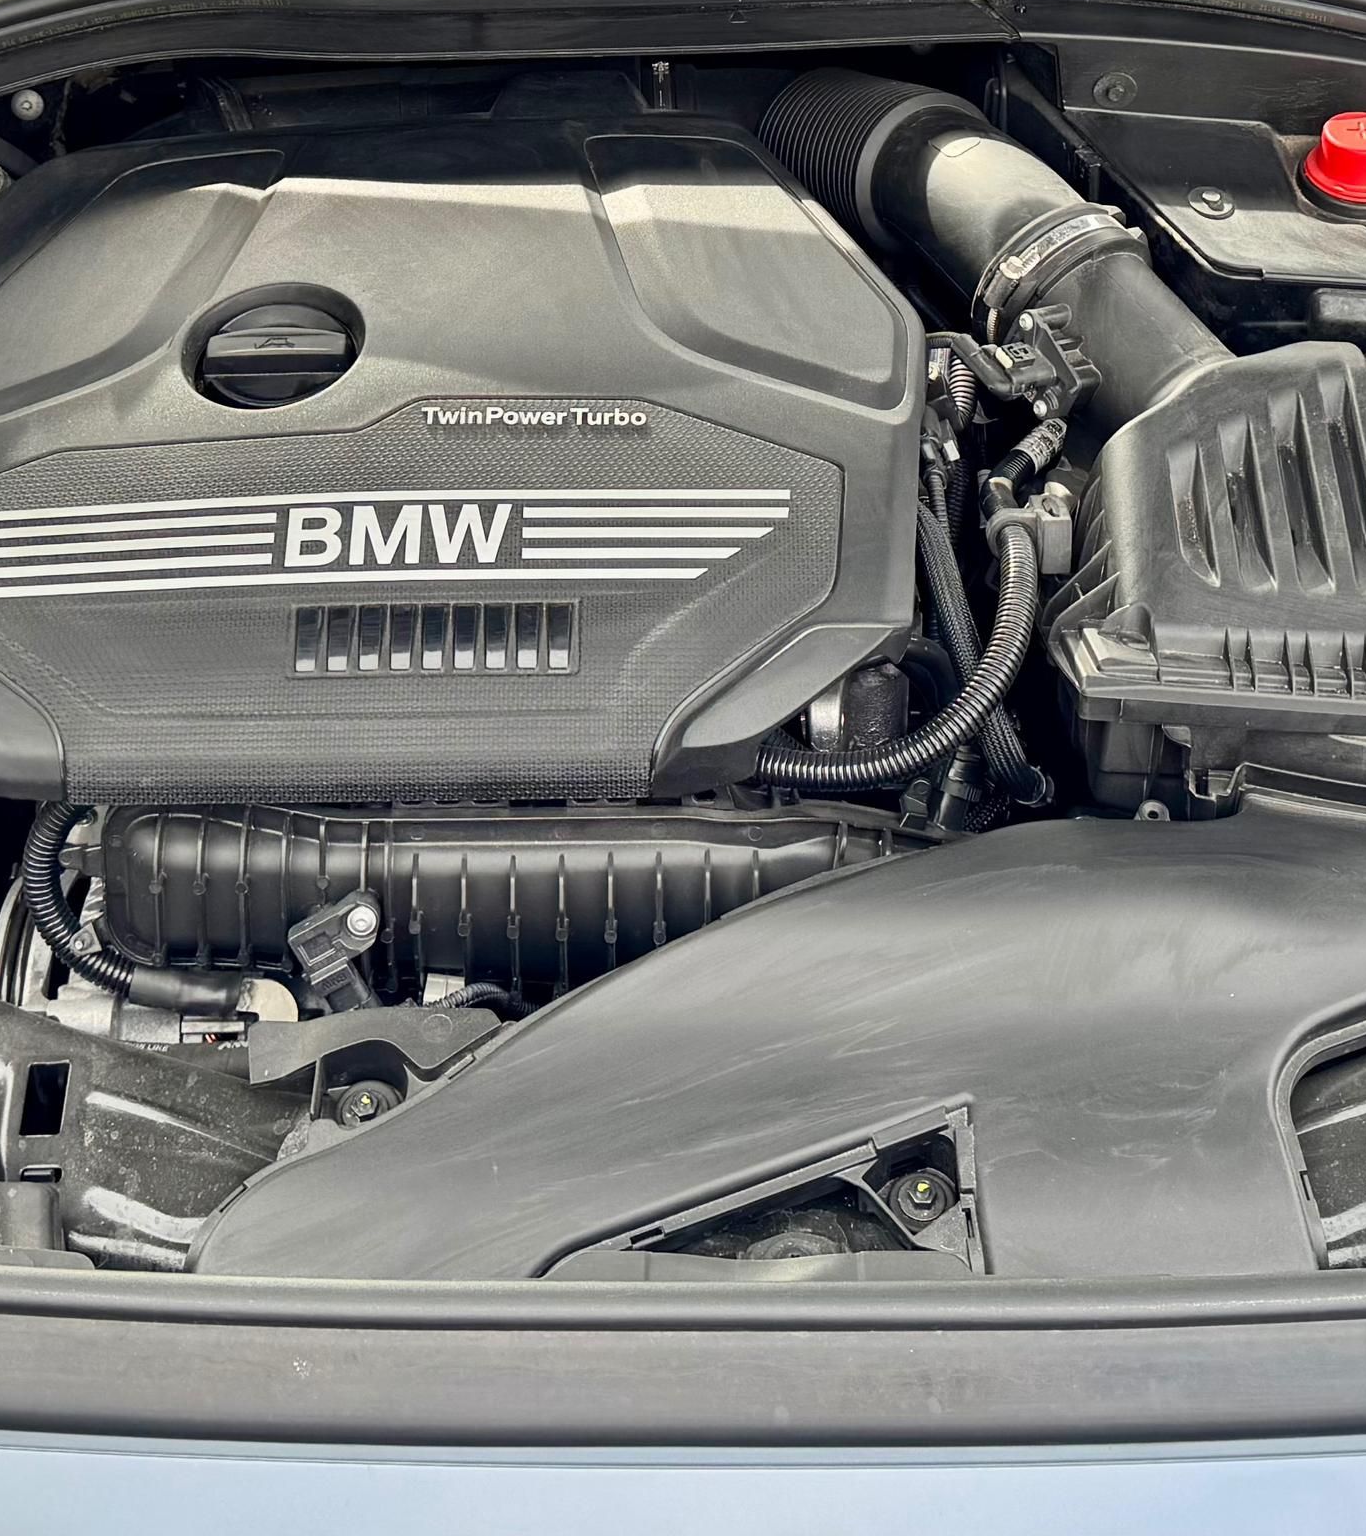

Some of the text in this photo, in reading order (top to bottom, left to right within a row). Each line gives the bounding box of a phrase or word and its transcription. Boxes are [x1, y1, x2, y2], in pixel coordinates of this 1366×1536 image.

[421, 406, 647, 426] TwinPower Turbo
[284, 503, 513, 568] BMW
